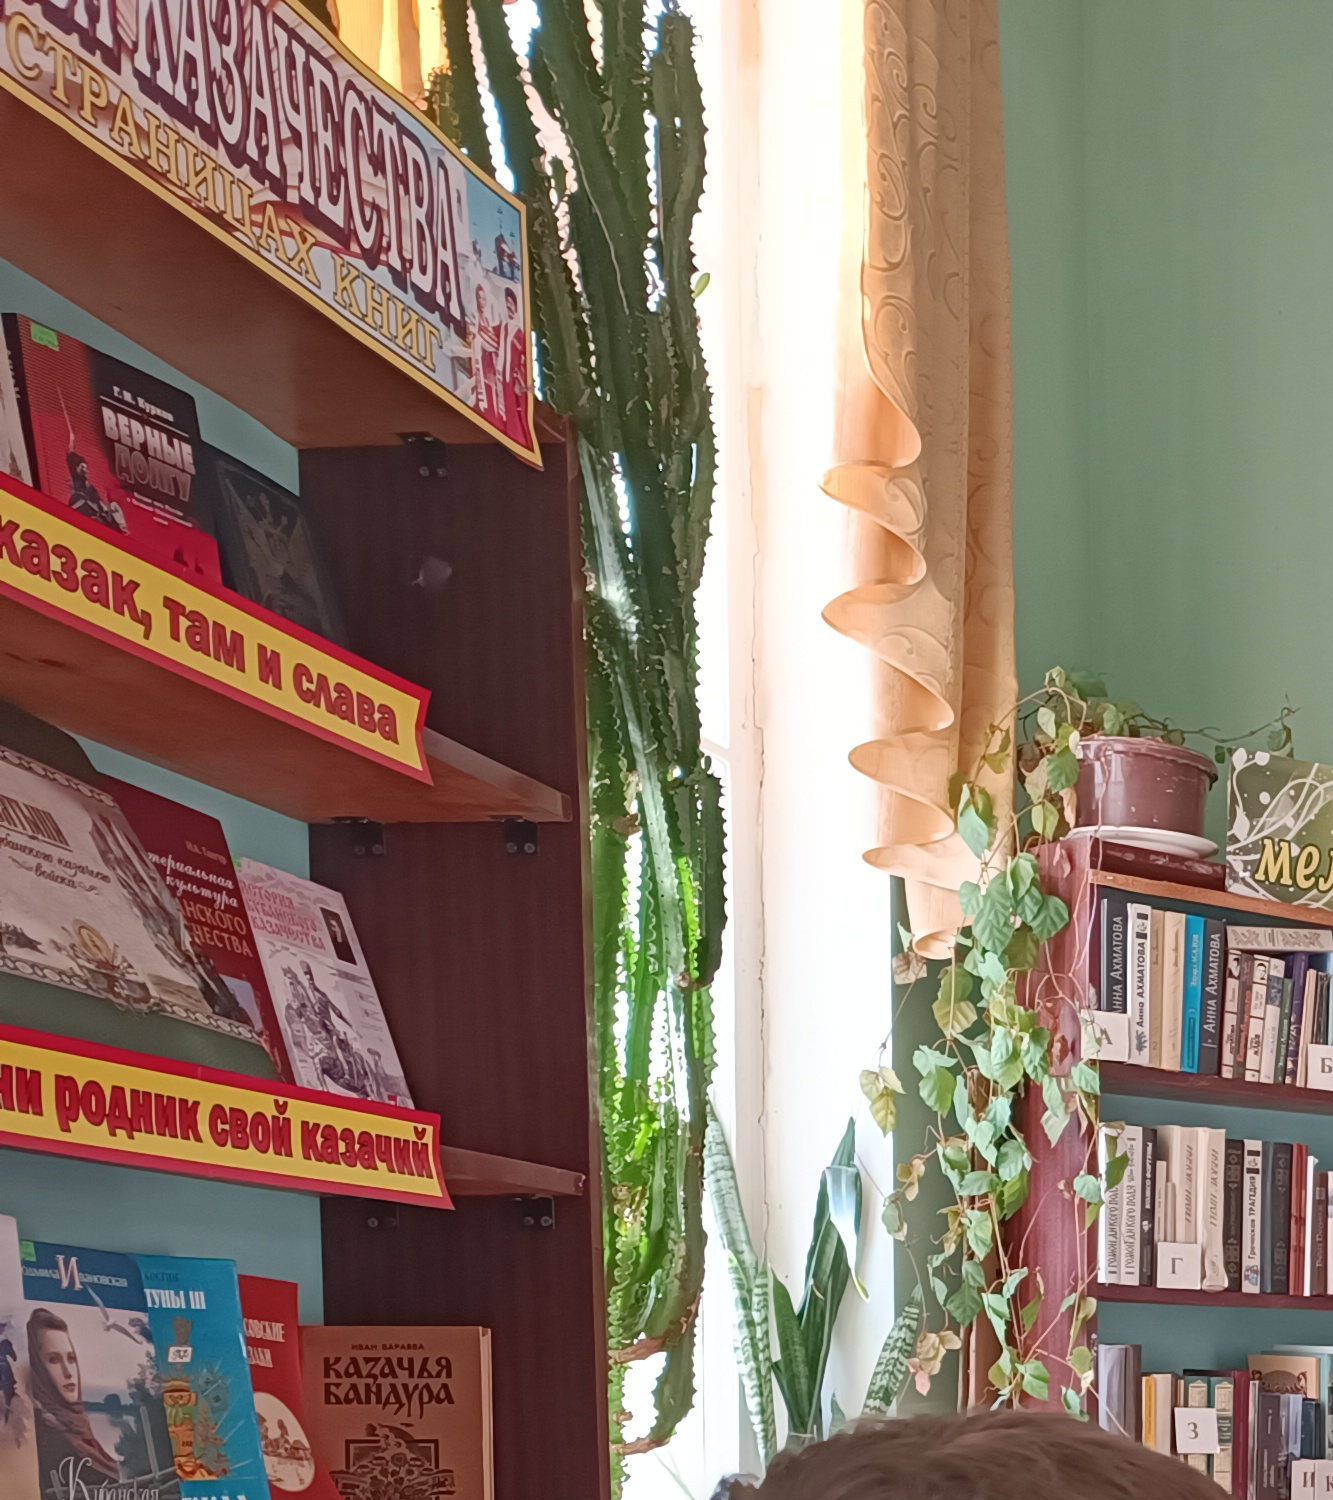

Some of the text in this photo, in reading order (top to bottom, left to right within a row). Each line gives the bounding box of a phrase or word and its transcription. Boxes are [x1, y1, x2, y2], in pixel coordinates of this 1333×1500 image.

[6, 11, 444, 371] СТРАНИЦАХ КНИГ
[102, 405, 196, 476] ВЕРНЫЕ
[114, 441, 192, 503] ДОЛГУ
[163, 595, 246, 674] там
[257, 643, 282, 691] и
[293, 662, 399, 745] слава
[147, 850, 235, 891] териальная
[165, 874, 240, 909] культура
[240, 879, 294, 912] ИСТОРИЯ
[179, 898, 248, 936] НСКОГО
[244, 898, 318, 933] КУБАНСКОГО
[249, 914, 327, 952] КАЗАЧЕСТВА
[1135, 940, 1147, 999] АХМАТОВА
[1204, 933, 1222, 996] АХМАТОВА
[1320, 1057, 1333, 1074] Б
[0, 1062, 434, 1180] ни родник свой казачий
[1248, 1175, 1258, 1217] ТРАГЕДИЯ
[1170, 1257, 1183, 1274] Г
[242, 1317, 285, 1343] СОВСКИЕ
[350, 1342, 425, 1352] ИВАН ВАРАВВА
[322, 1354, 453, 1386] КАЗАЧЬЯ
[323, 1381, 455, 1419] БАНДУРА
[1186, 1422, 1199, 1440] З
[1302, 1470, 1315, 1489] И
